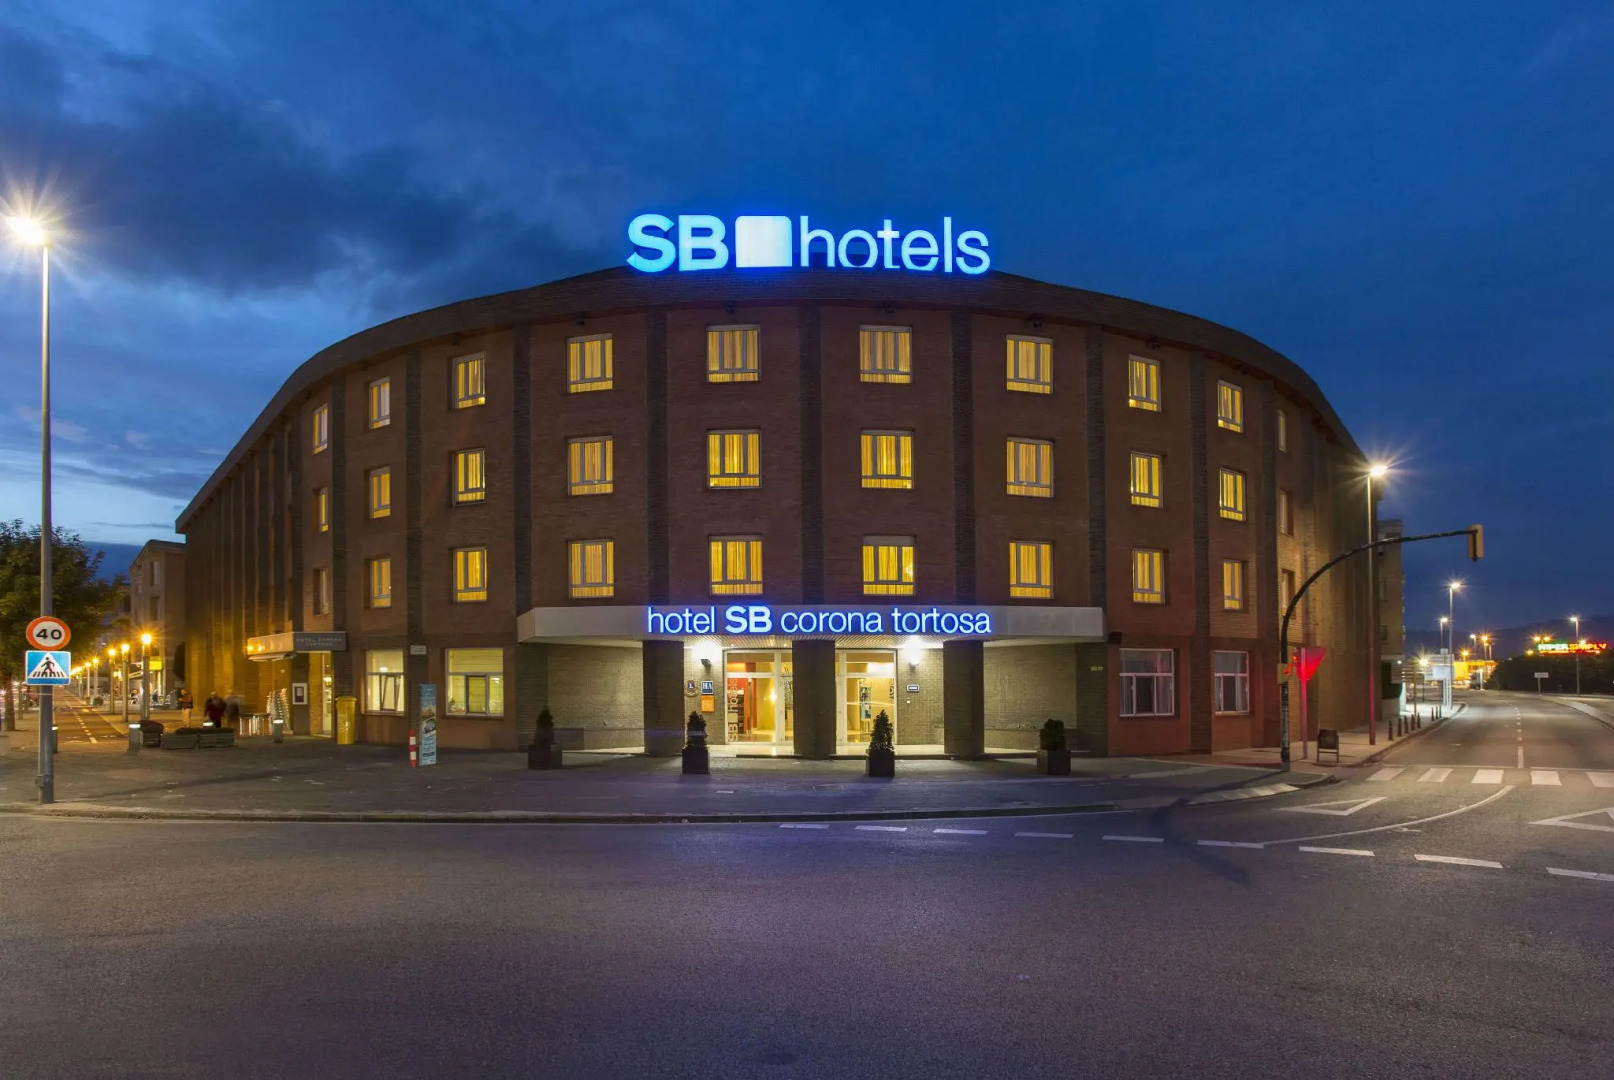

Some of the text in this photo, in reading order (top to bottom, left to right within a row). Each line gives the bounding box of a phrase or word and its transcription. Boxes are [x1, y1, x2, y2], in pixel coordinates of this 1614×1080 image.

[626, 213, 990, 275] SB hotels
[648, 606, 991, 633] hotel SB corona tortosa
[36, 629, 62, 640] 40
